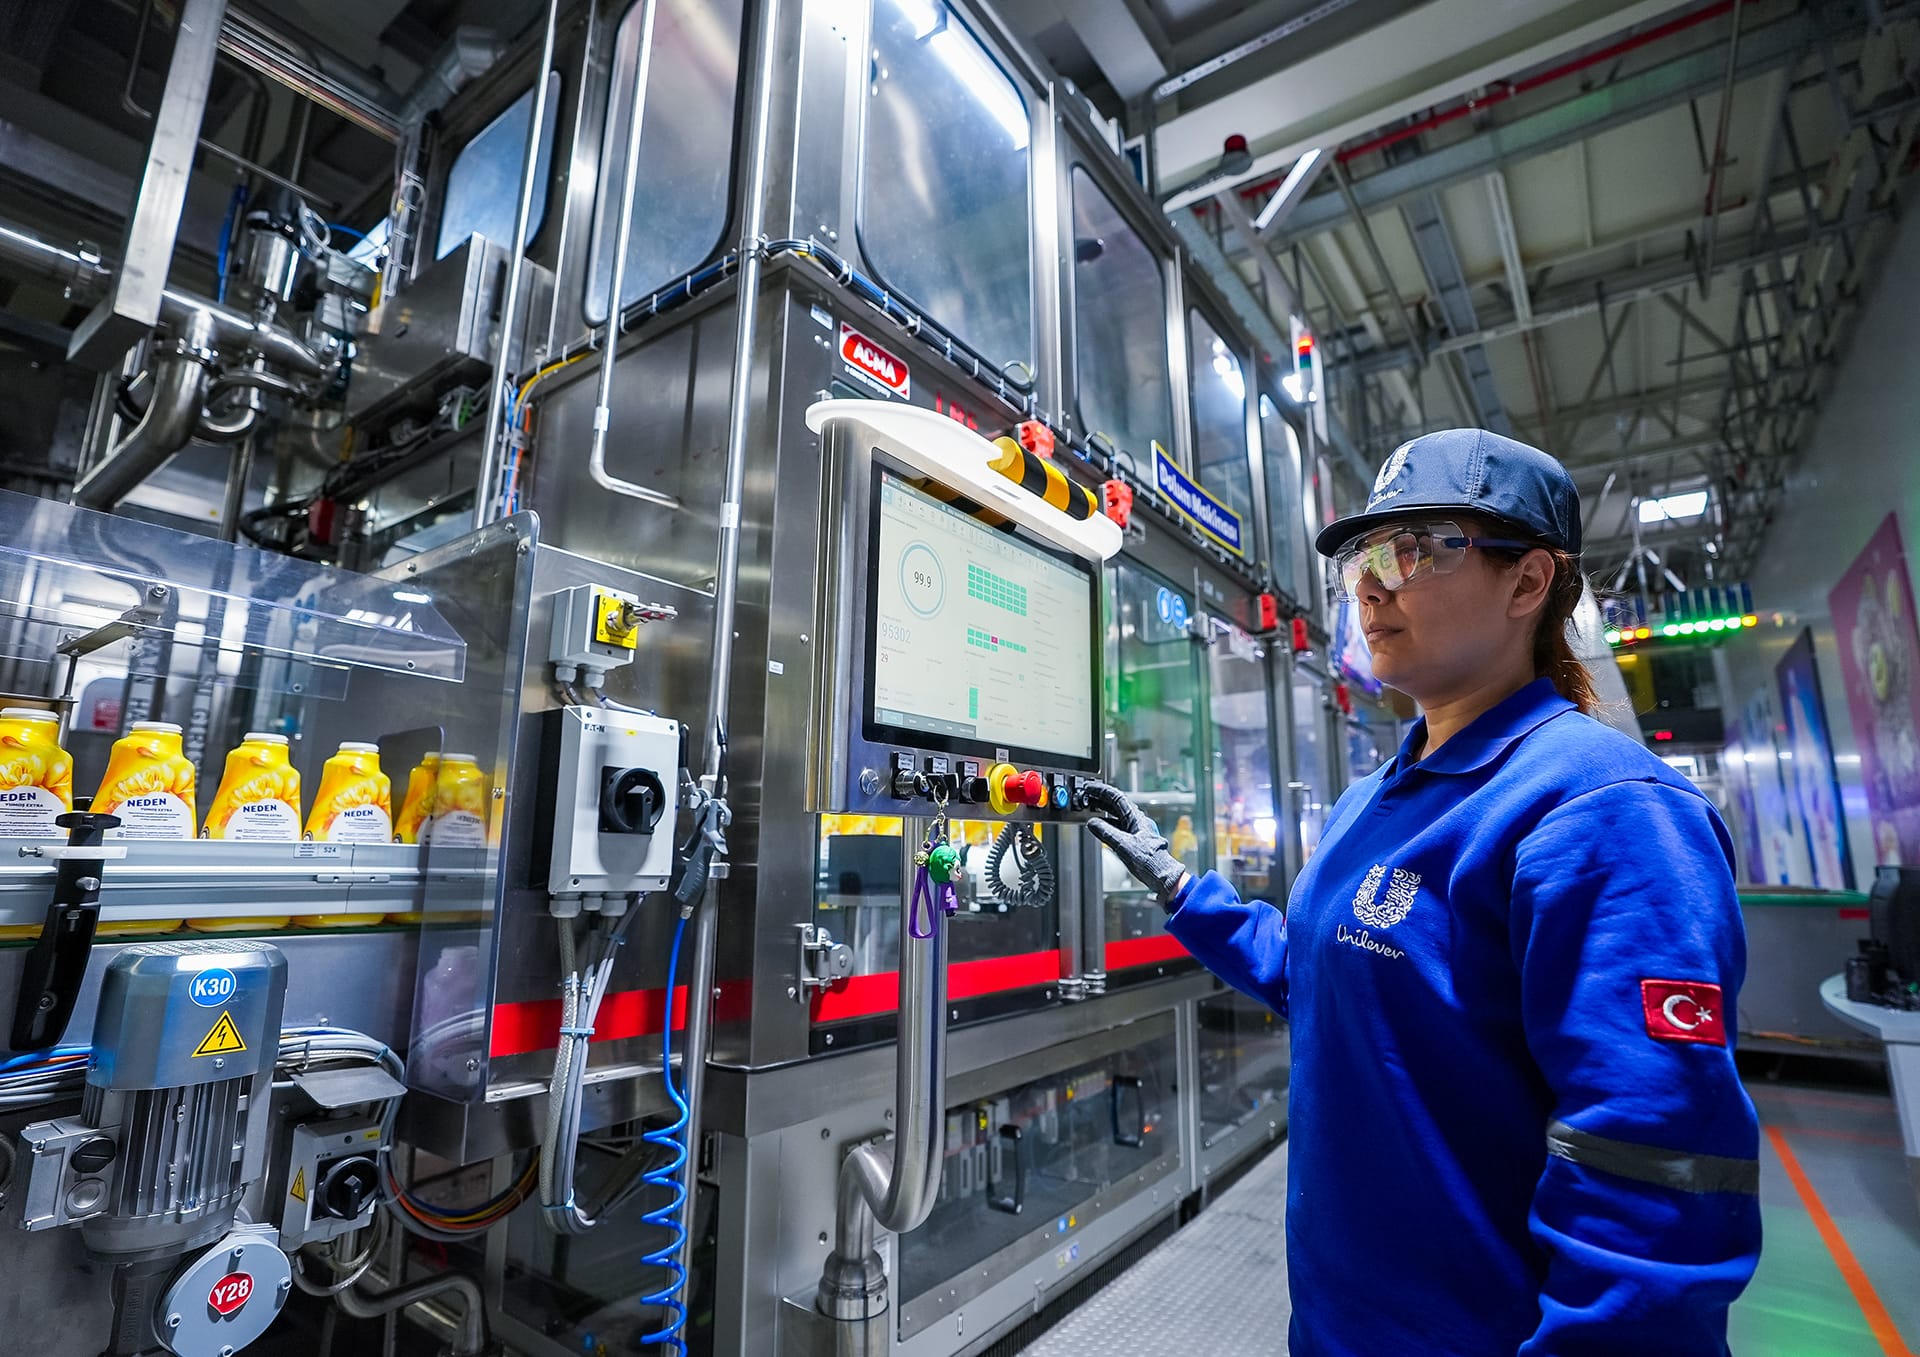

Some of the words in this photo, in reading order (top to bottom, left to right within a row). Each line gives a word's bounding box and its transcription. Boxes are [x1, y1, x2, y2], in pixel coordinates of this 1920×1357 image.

[852, 341, 897, 384] ACMA
[1159, 462, 1192, 509] Dolum
[914, 571, 932, 588] 99.9
[882, 622, 911, 645] 95302
[880, 652, 889, 663] 29
[127, 797, 167, 808] NEDEN
[243, 804, 277, 813] NEDEN
[344, 809, 374, 818] NEDEN
[1336, 924, 1405, 960] Unilever
[194, 977, 231, 997] K30
[214, 1278, 249, 1306] Y28
